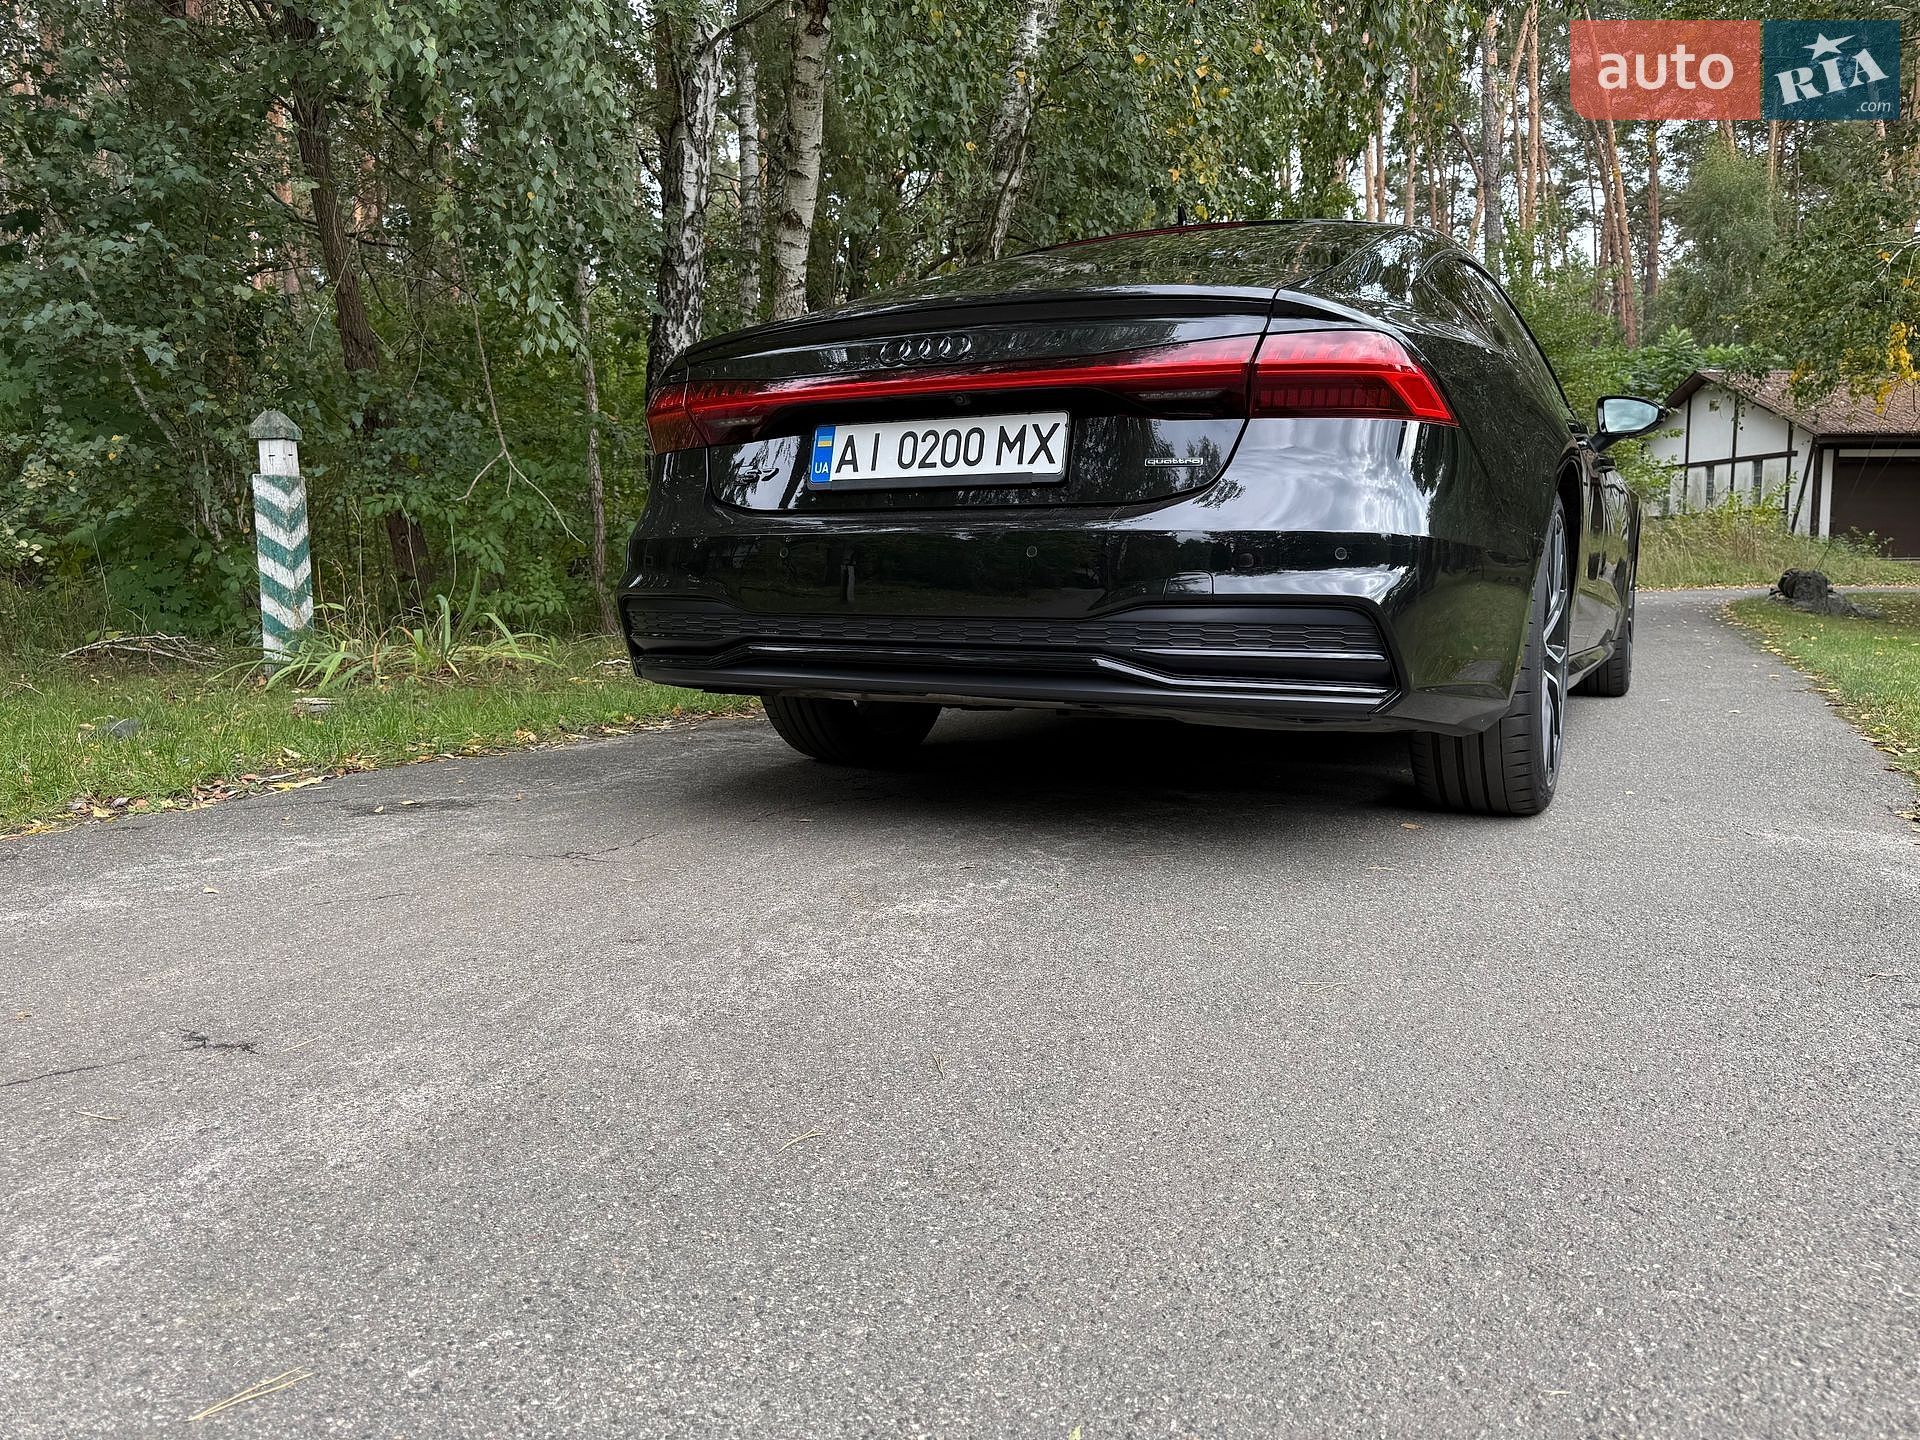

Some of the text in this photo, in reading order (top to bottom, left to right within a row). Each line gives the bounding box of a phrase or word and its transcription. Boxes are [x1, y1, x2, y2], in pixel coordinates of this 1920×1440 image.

[897, 427, 985, 469] 0200
[995, 422, 1061, 466] MX
[814, 461, 829, 474] UA
[1147, 457, 1200, 465] quattro
